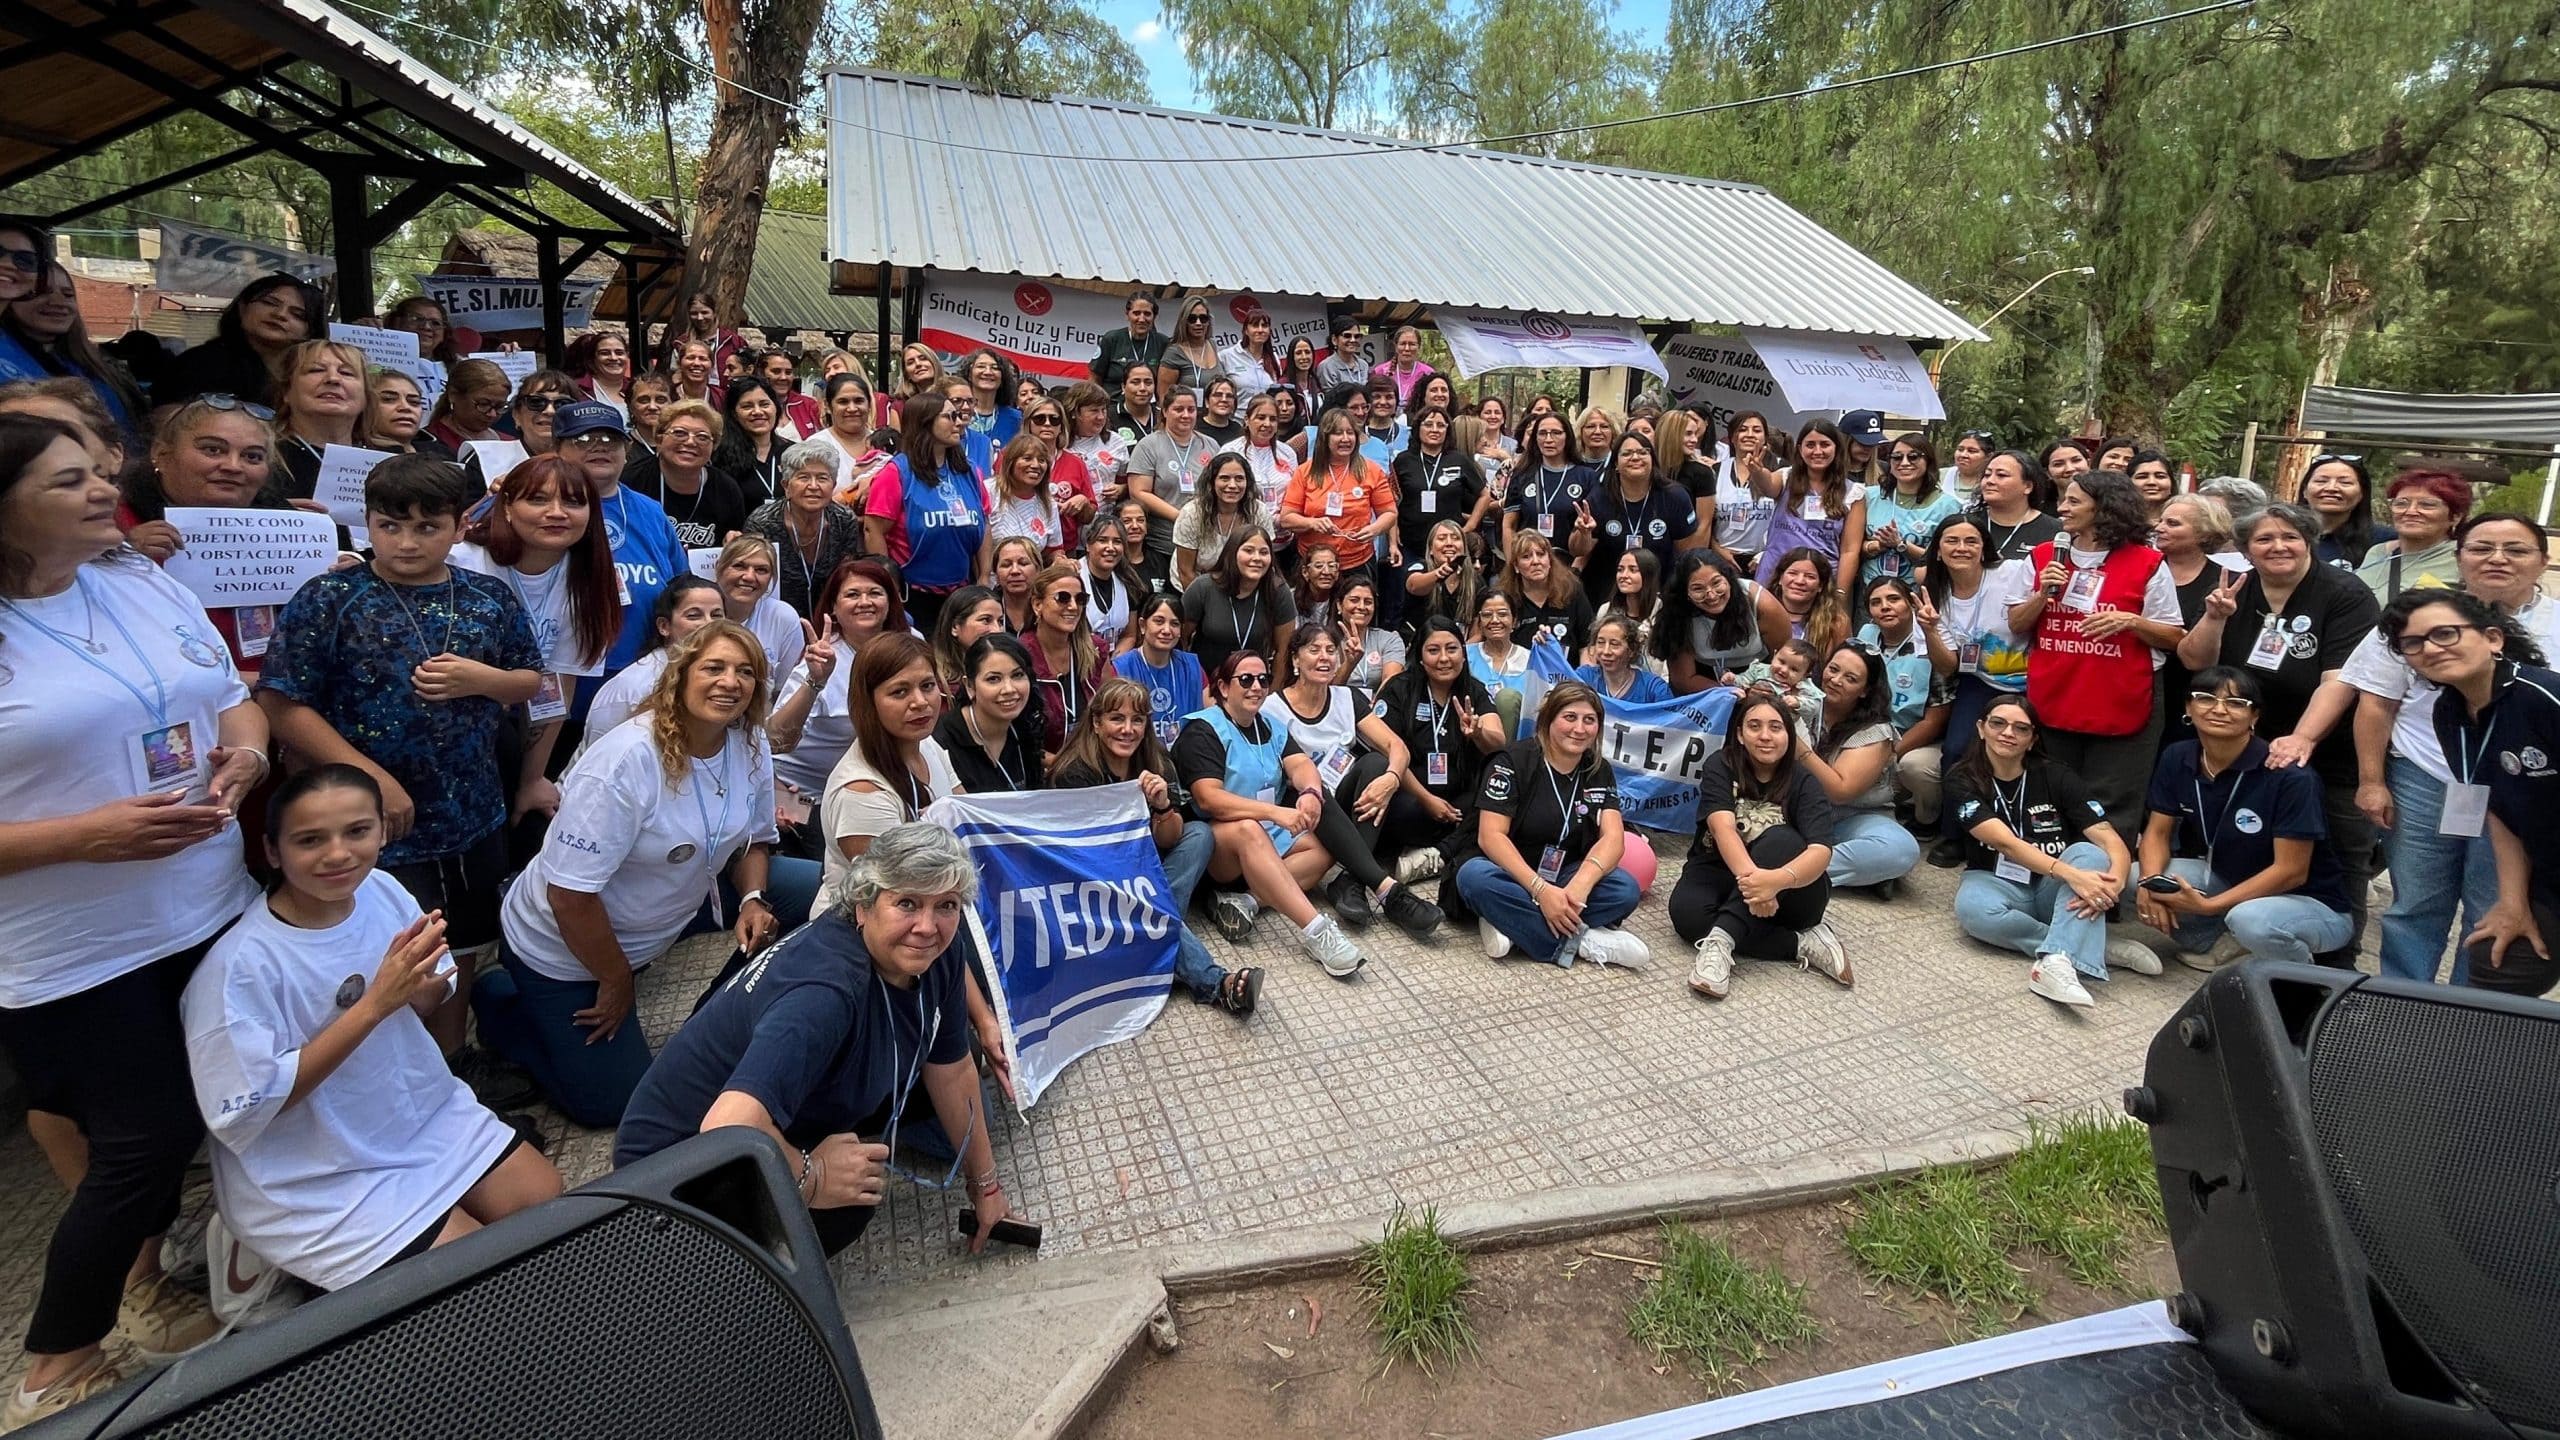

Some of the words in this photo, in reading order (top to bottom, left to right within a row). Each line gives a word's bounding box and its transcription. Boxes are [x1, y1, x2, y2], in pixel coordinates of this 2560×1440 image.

[929, 292, 1010, 328] Sindicato
[1015, 315, 1045, 336] Luz
[1050, 327, 1060, 342] y
[1065, 326, 1104, 346] Fuer
[1467, 316, 1521, 327] MUJERES
[1280, 318, 1326, 338] Fuerza
[364, 331, 400, 340] TRABAJO
[987, 327, 1019, 350] San
[1023, 336, 1062, 358] Juan
[1669, 342, 1719, 364] MUJERES
[1720, 350, 1769, 373] TRABAJ
[1785, 358, 1848, 377] Unión
[1848, 361, 1913, 383] Judicial
[1686, 366, 1774, 397] SINDICALISTAS
[339, 466, 368, 476] POSIB
[207, 516, 254, 527] TIENE
[258, 517, 304, 527] COMO
[265, 533, 328, 544] LIMITAR
[186, 551, 196, 560] Y
[201, 549, 323, 561] OBSTACULIZAR
[215, 566, 236, 577] LA
[242, 565, 295, 576] LABOR
[213, 581, 293, 593] SINDICAL.
[2040, 637, 2053, 651] DE
[2055, 639, 2122, 658] MENDOZA
[1489, 778, 1509, 790] SAT
[1634, 799, 1641, 812] Y
[1643, 794, 1680, 810] AFINES
